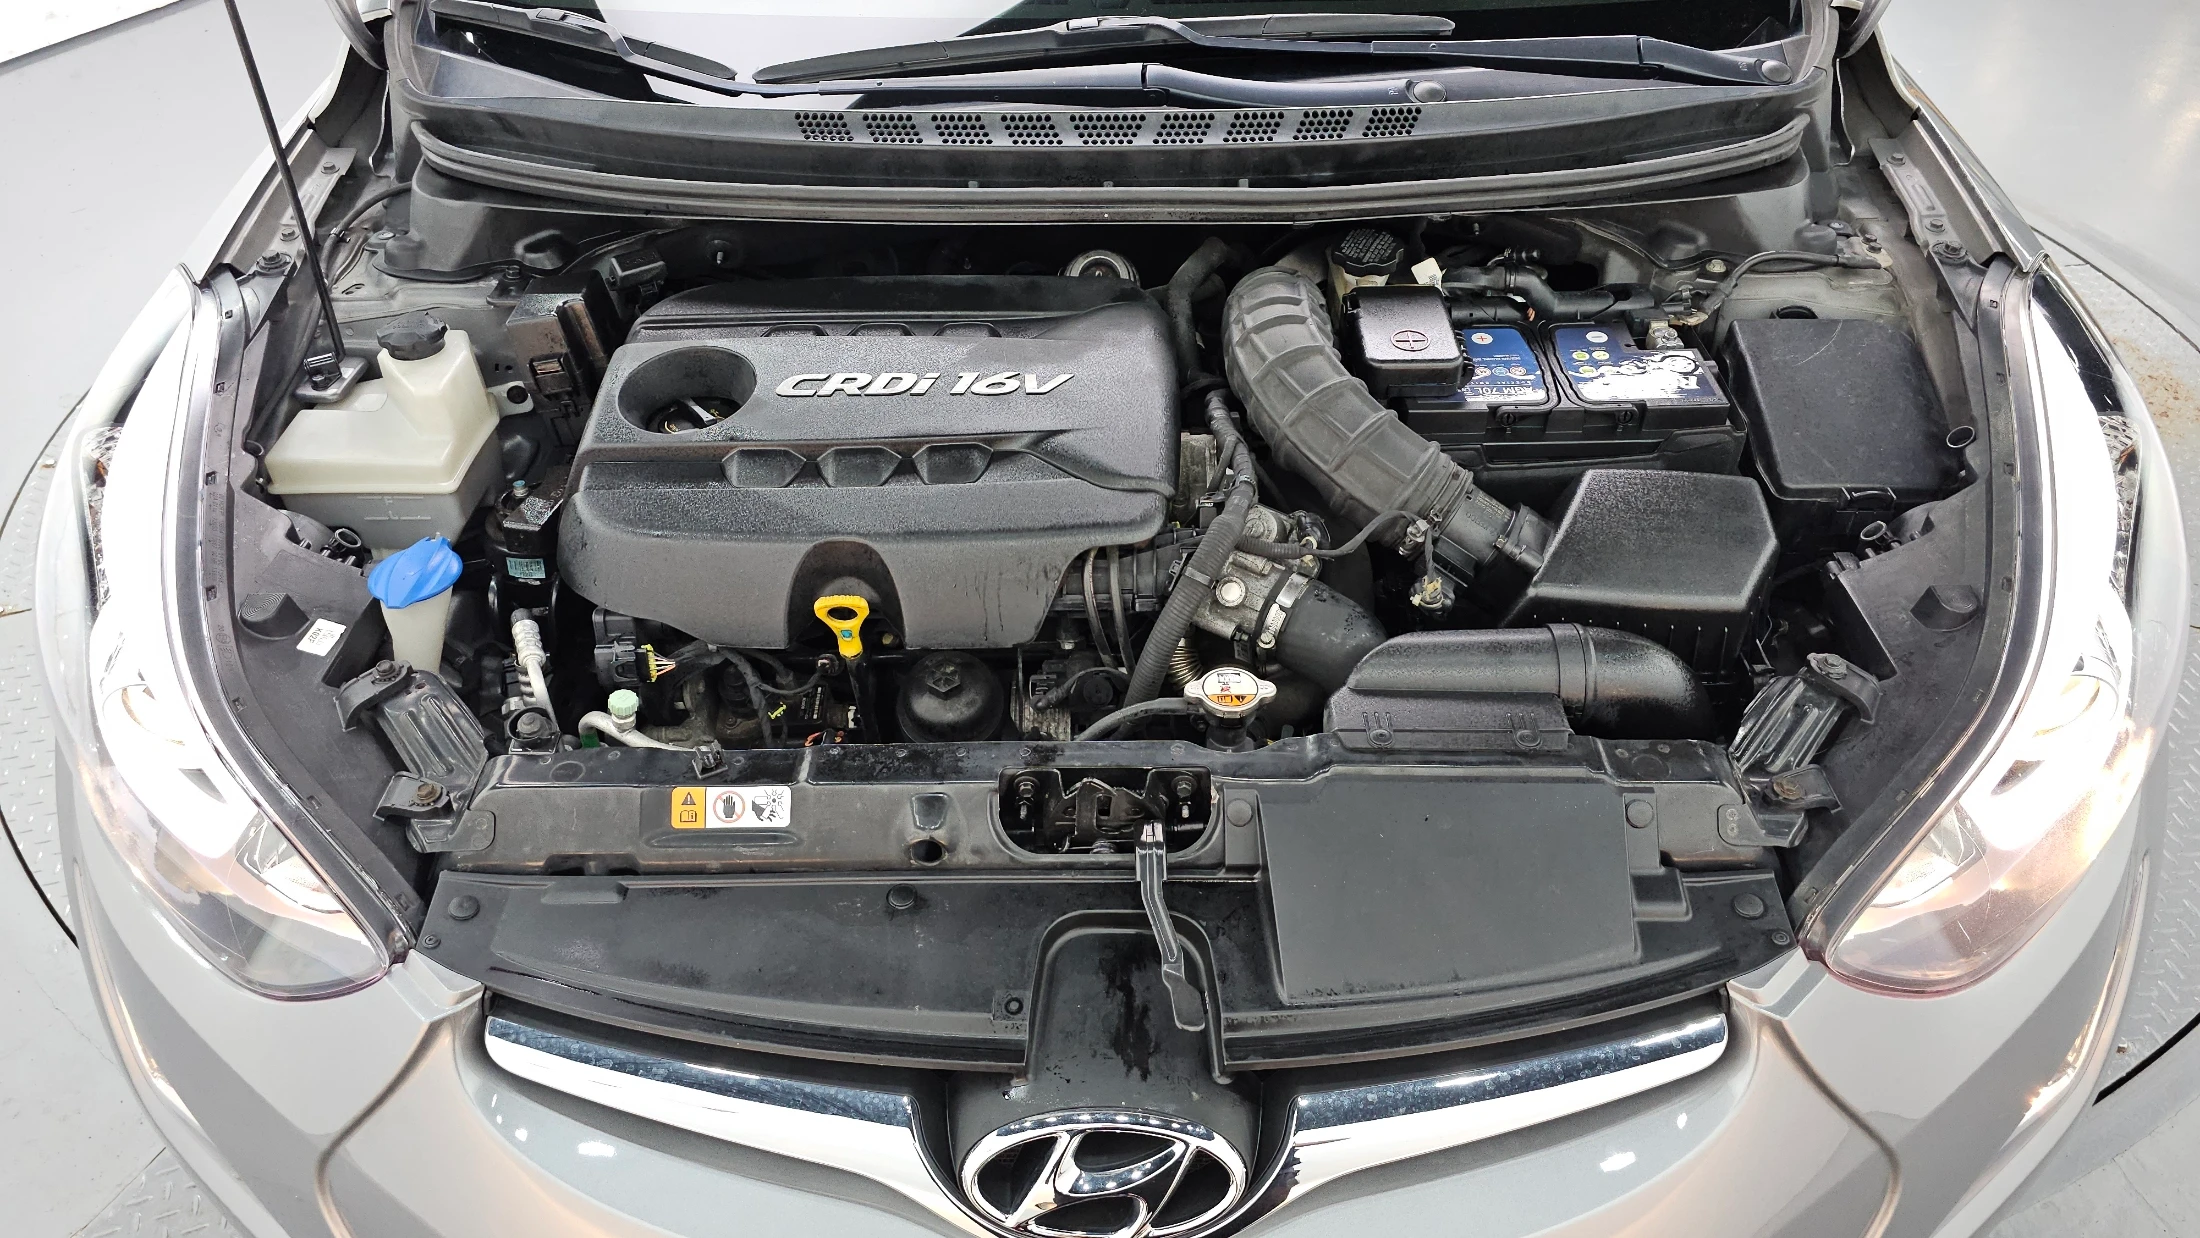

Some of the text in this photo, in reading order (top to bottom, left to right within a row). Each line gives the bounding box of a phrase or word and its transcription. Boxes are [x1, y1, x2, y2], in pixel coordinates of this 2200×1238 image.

[775, 371, 1075, 396] CRDi 16V
[1474, 386, 1498, 395] 70L
[1503, 386, 1533, 395] AGM
